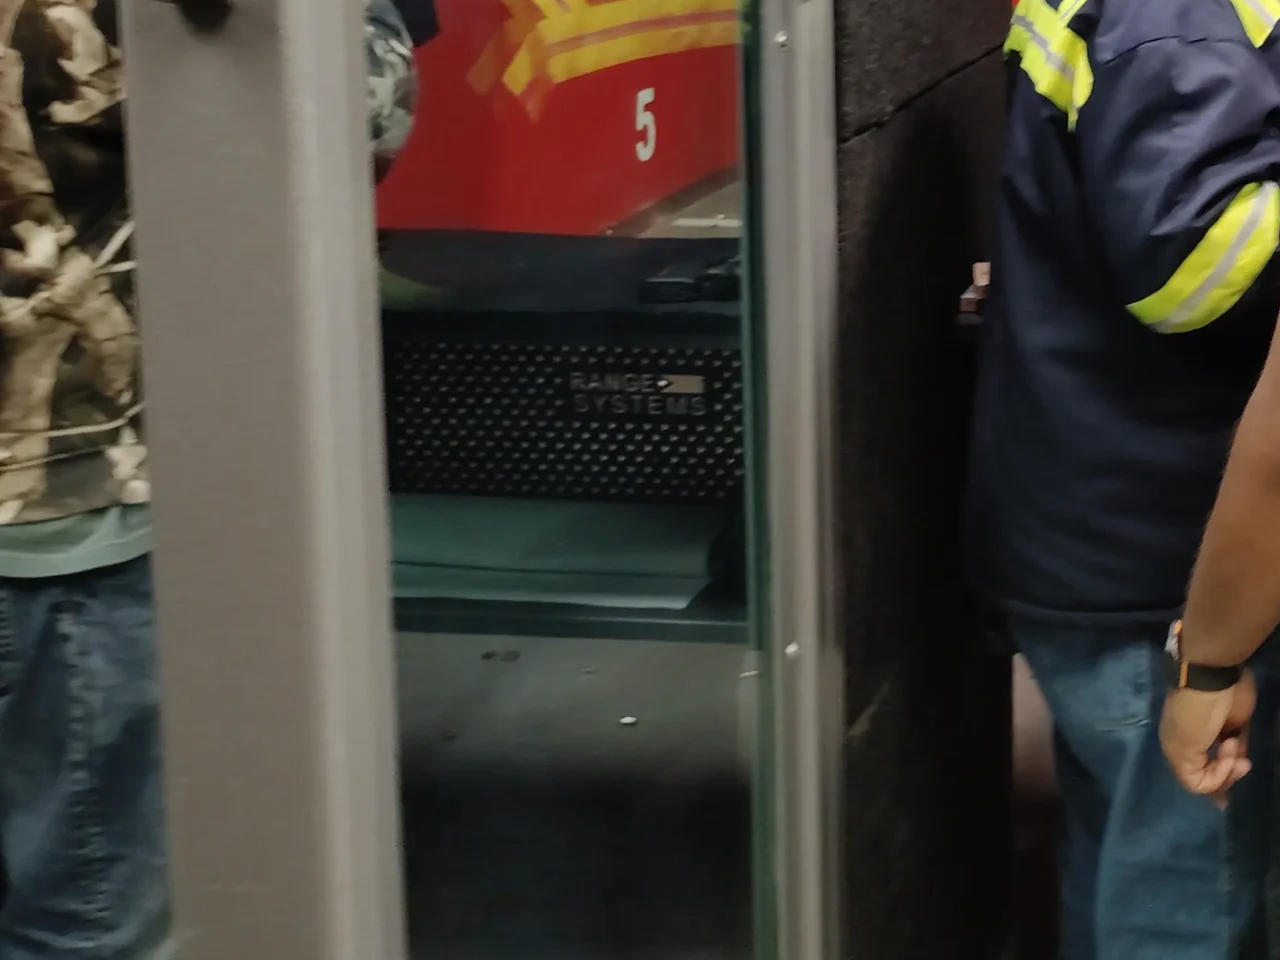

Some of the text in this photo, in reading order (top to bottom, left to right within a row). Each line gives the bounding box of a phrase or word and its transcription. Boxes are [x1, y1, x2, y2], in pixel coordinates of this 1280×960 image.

[635, 88, 657, 162] 5
[570, 372, 656, 392] RANGE
[574, 394, 707, 415] SYSTEMS
